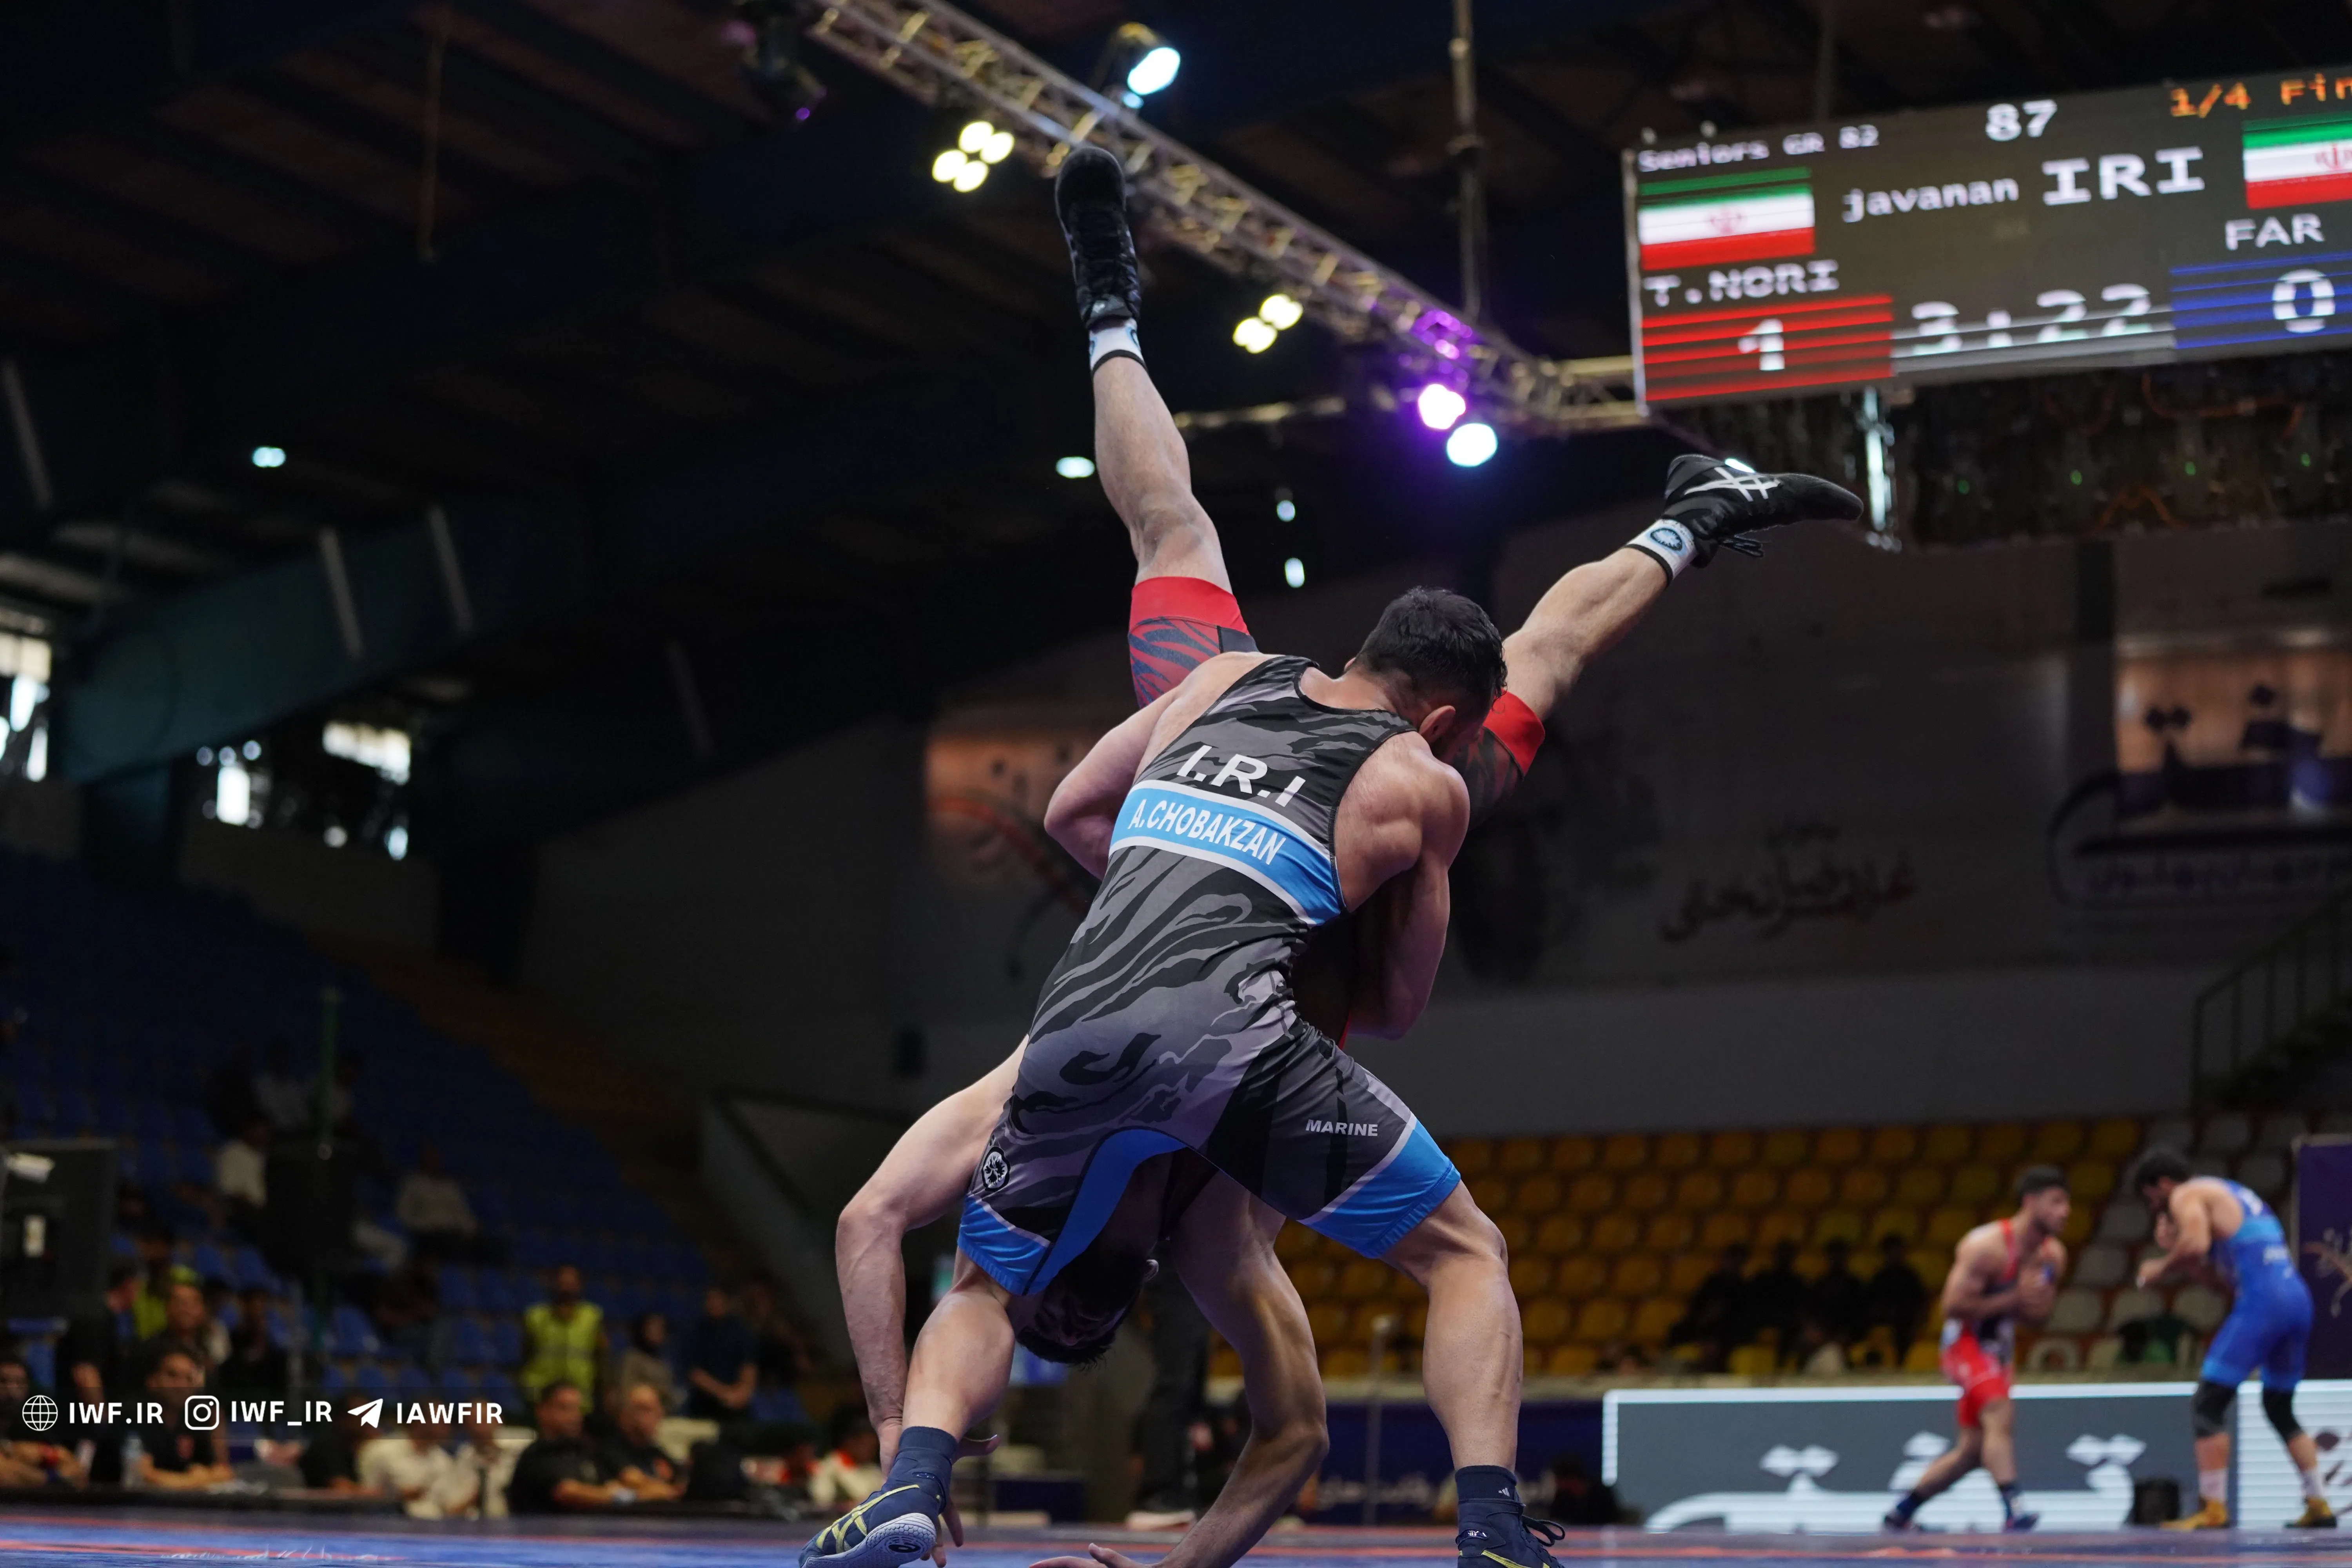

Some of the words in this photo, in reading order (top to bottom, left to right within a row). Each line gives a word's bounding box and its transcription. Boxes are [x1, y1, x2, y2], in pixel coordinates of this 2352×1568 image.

[1985, 99, 2058, 141] 87
[2170, 82, 2251, 118] 1/4
[1637, 142, 1769, 172] Seniors
[1783, 132, 1825, 155] GR
[1839, 124, 1879, 149] 82
[2041, 145, 2205, 205] IRI
[1842, 178, 2019, 223] javanan
[2225, 213, 2325, 250] FAR
[1643, 259, 1839, 307] T.NORI
[2272, 268, 2335, 333] 0
[1738, 318, 1785, 371] 1
[1177, 745, 1306, 807] I.R.I
[1128, 799, 1286, 865] A.CHOBAKZAN
[1306, 1119, 1378, 1136] MARINE
